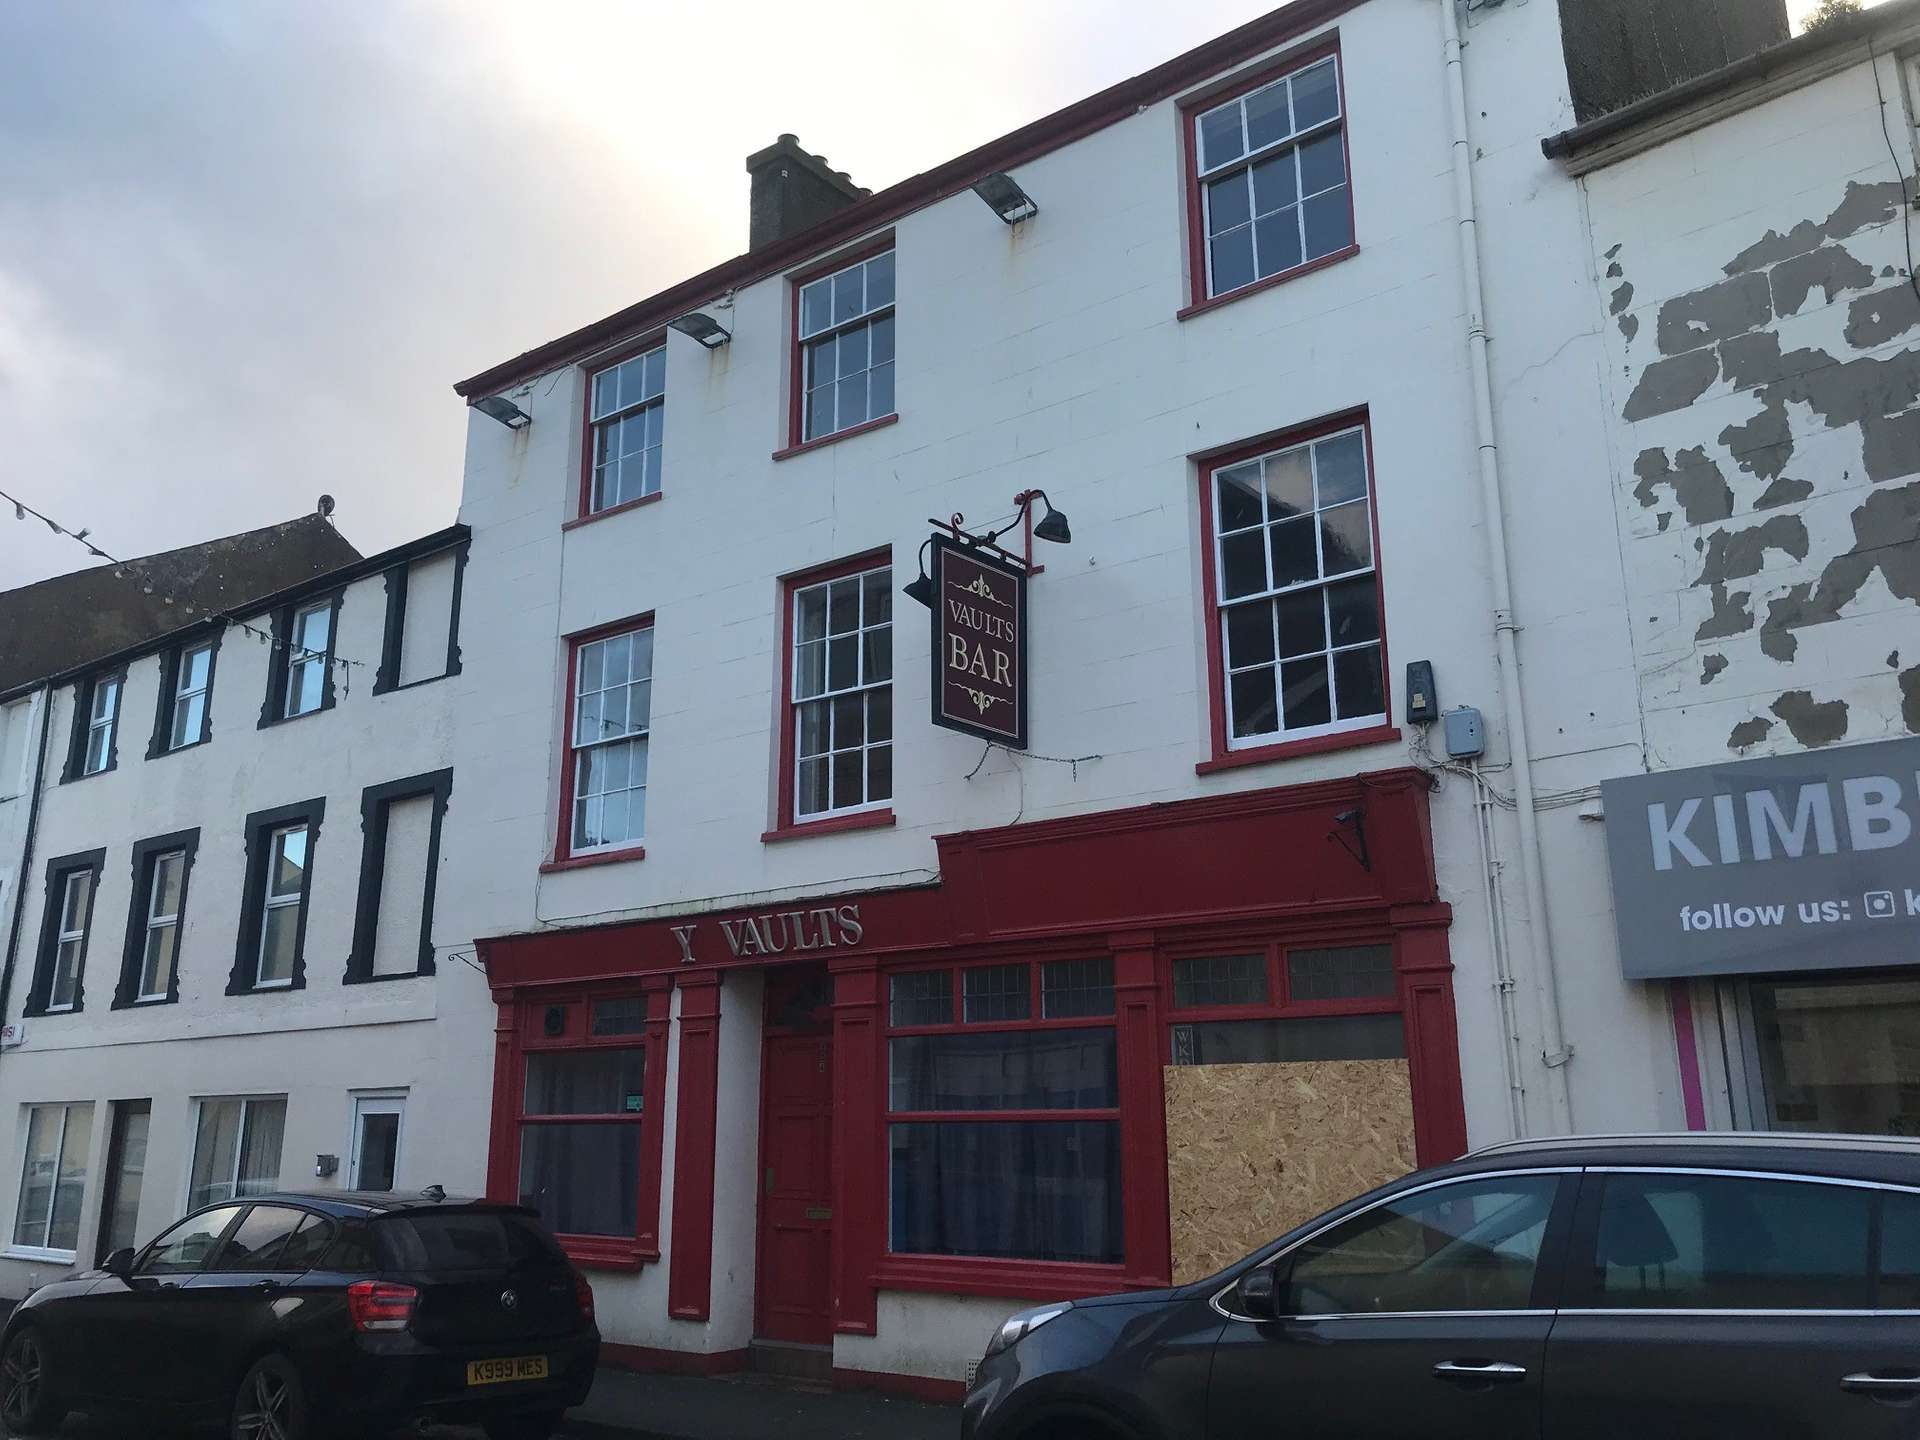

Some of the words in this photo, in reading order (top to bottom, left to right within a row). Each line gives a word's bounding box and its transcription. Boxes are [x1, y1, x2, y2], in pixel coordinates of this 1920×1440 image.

[948, 599, 1014, 643] VAULTS
[948, 632, 1012, 688] BAR
[1647, 769, 1920, 871] KIMB
[670, 924, 697, 963] Y
[719, 904, 864, 957] VAULTS
[1680, 903, 1785, 932] follow
[1798, 900, 1852, 924] us:
[474, 1361, 514, 1382] K999
[517, 1358, 543, 1377] MES
